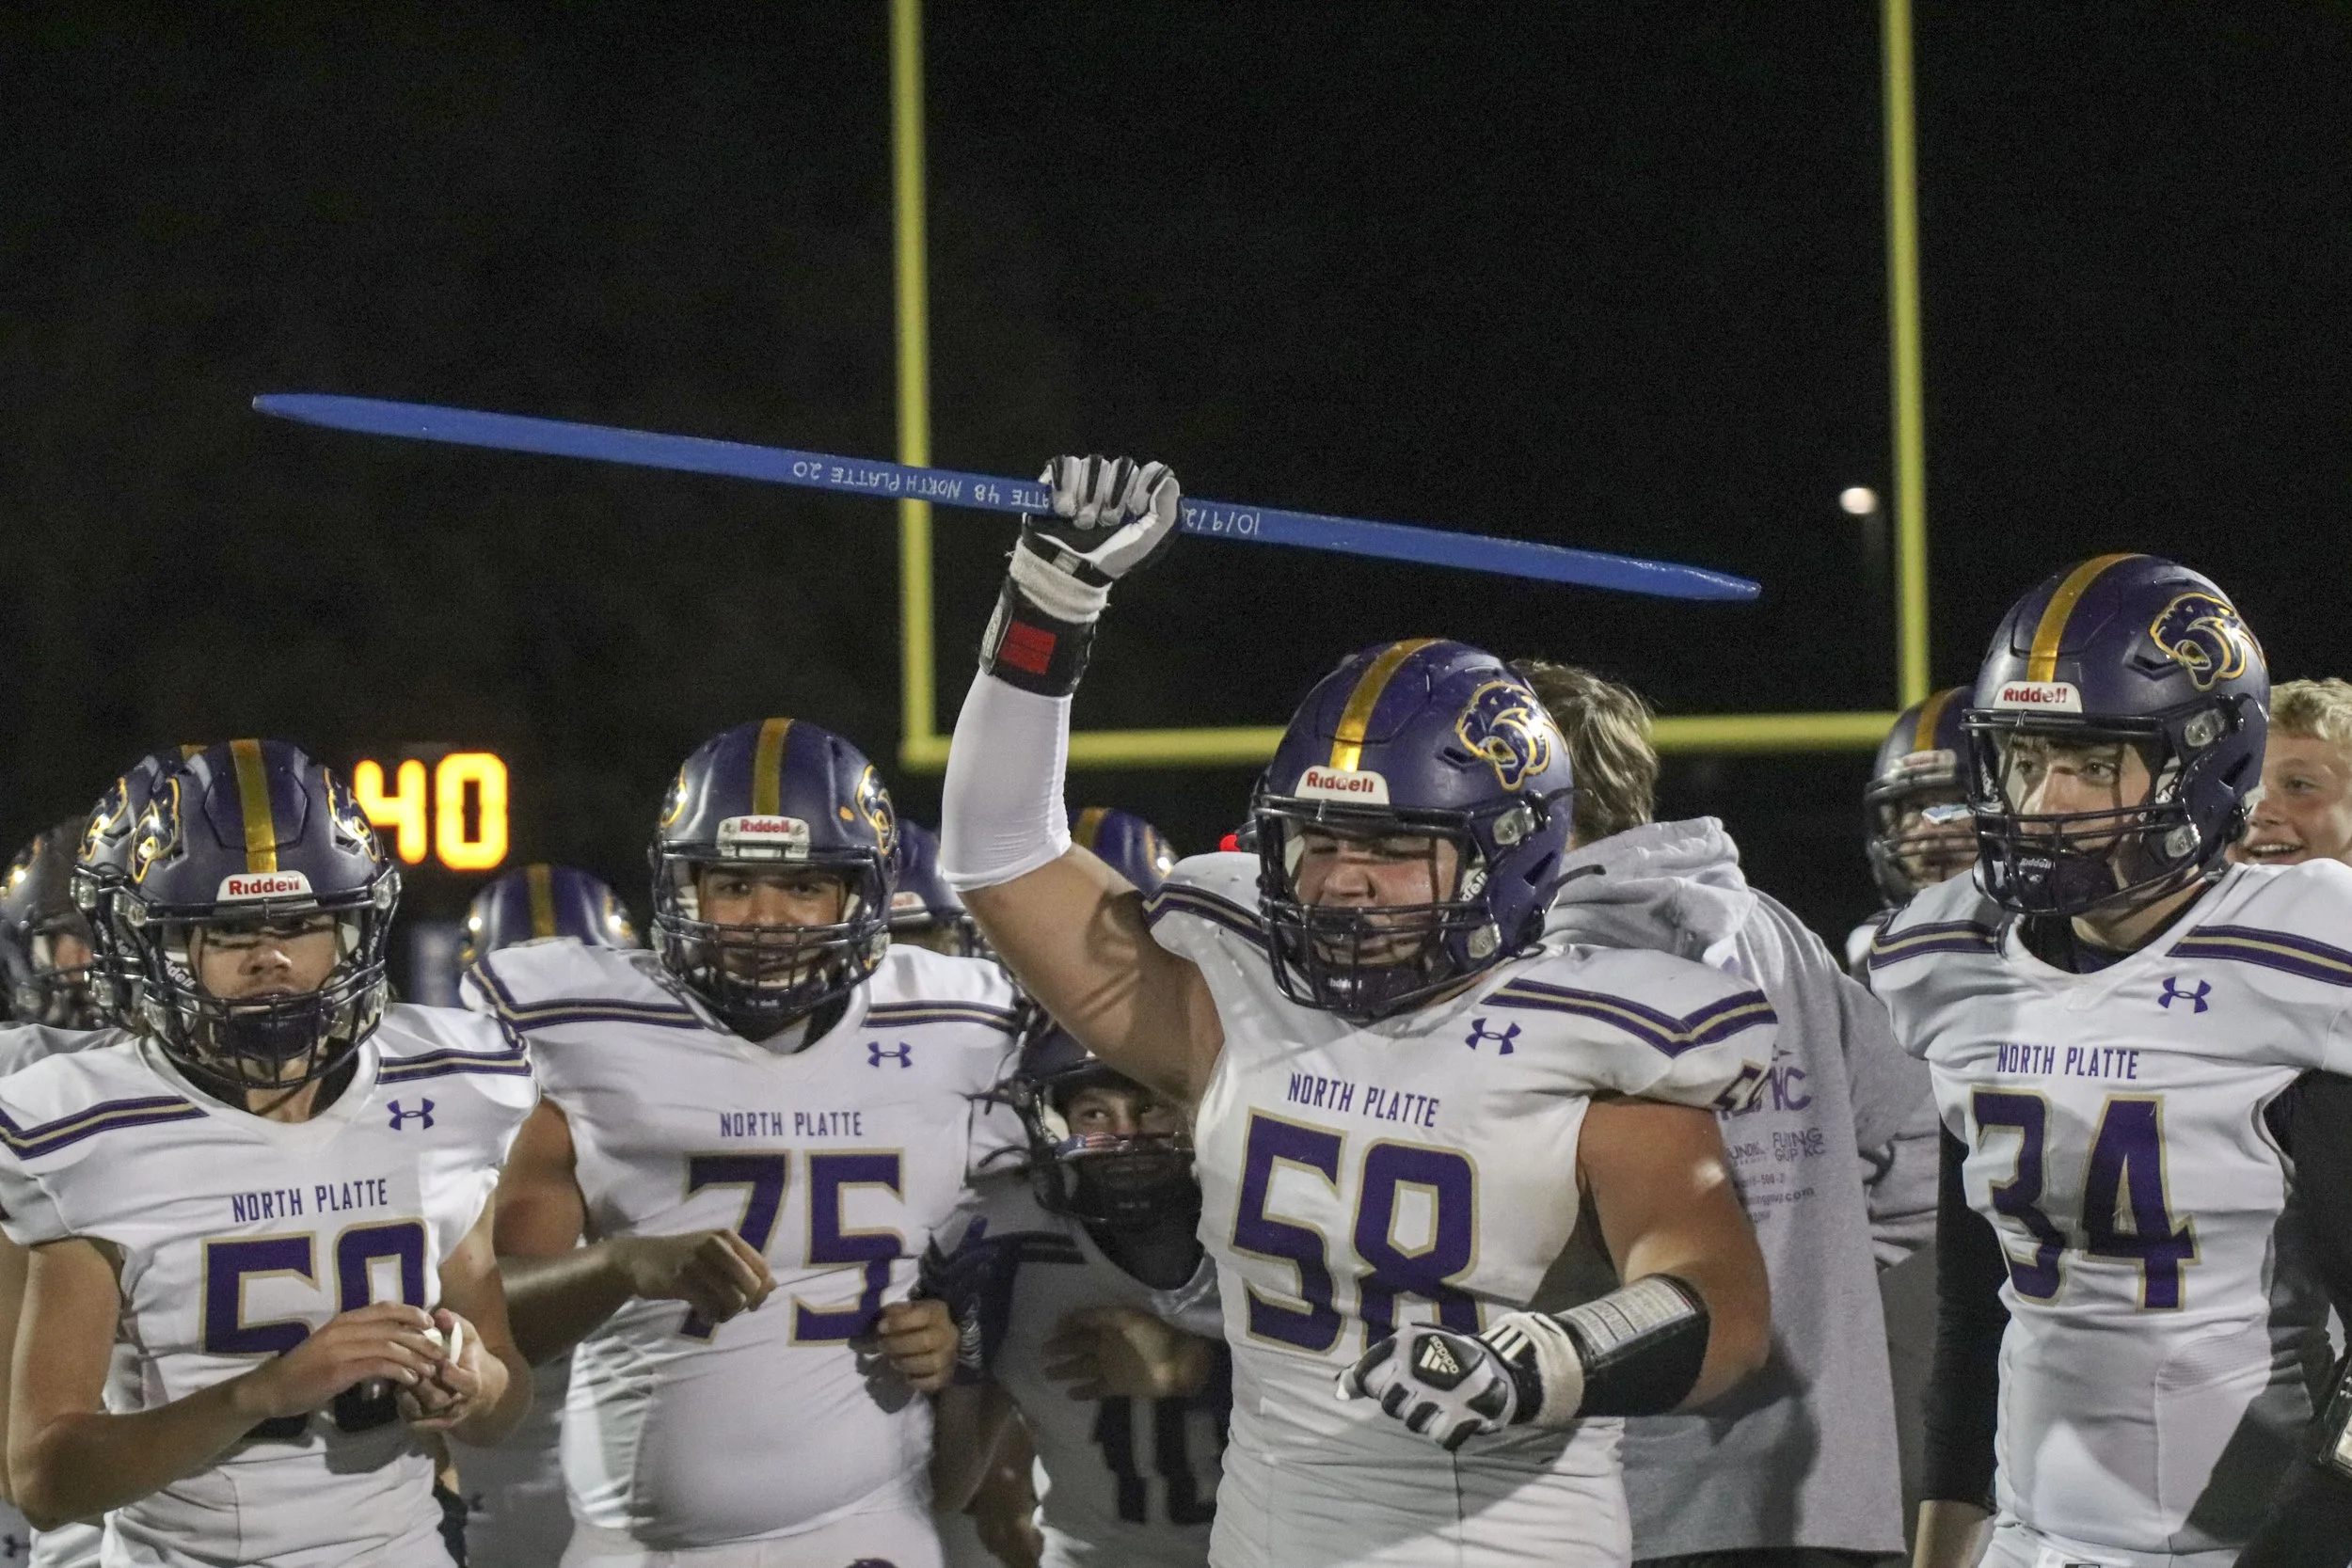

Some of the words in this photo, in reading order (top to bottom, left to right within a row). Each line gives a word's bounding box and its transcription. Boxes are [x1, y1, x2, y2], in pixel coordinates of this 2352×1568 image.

[793, 461, 822, 481] 20
[831, 467, 899, 491] PLATTE
[906, 474, 962, 499] NORTH
[974, 483, 1000, 505] 48
[1010, 489, 1050, 510] ATTE
[1184, 508, 1261, 535] 10/9/2
[2003, 687, 2067, 704] Riddell
[1306, 771, 1375, 793] Riddell
[354, 751, 508, 871] 40
[739, 818, 790, 833] Riddell
[228, 876, 300, 895] Riddell
[1996, 1043, 2056, 1074] NORTH
[2064, 1045, 2139, 1080] PLATTE
[1287, 1071, 1356, 1113] NORTH
[1362, 1085, 1440, 1128] PLATTE
[720, 1111, 783, 1137] NORTH
[794, 1111, 863, 1136] PLATTE
[231, 1187, 303, 1223] NORTH
[314, 1178, 388, 1212] PLATTE
[1969, 1085, 2202, 1312] 34
[1228, 1105, 1480, 1356] 58
[677, 1148, 906, 1347] 75
